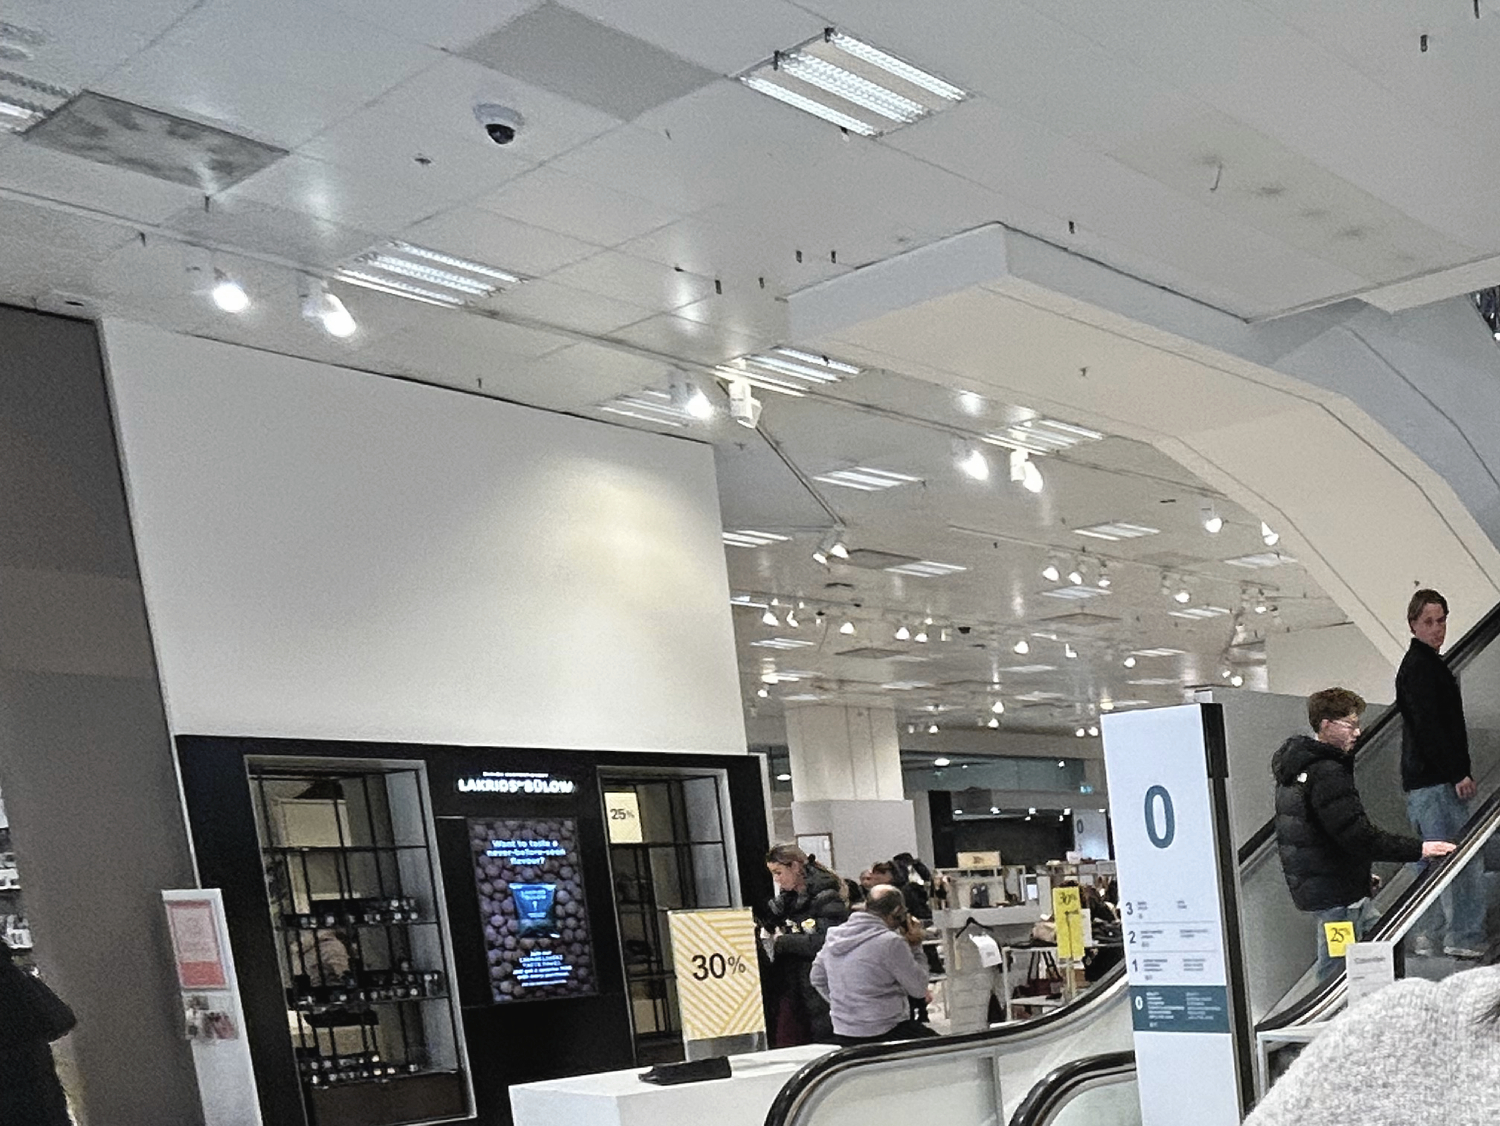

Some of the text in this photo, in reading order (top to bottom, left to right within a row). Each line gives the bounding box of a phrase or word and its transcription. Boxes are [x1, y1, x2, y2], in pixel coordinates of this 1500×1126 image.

[610, 808, 635, 820] 25%
[1144, 785, 1175, 849] 0
[1125, 901, 1134, 916] 3
[1127, 930, 1137, 944] 2
[691, 952, 746, 981] 30%
[1132, 958, 1138, 972] 1
[1135, 995, 1144, 1011] 0
